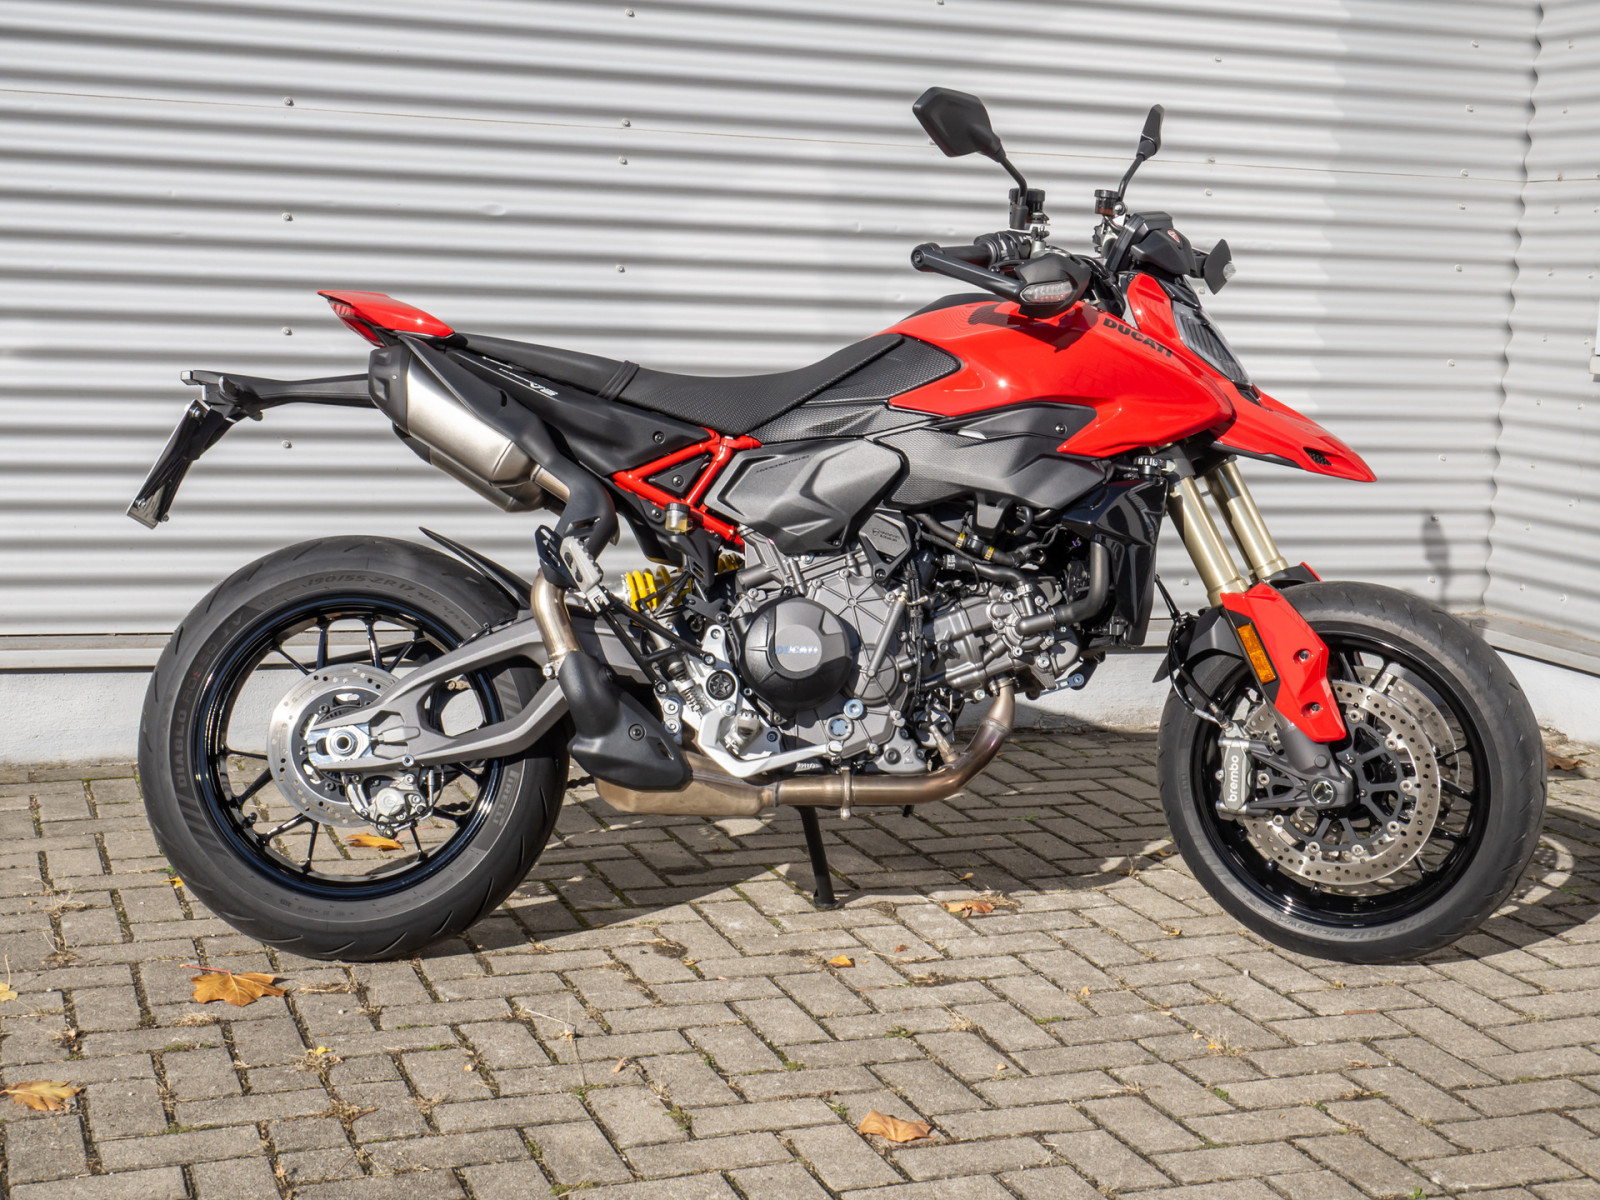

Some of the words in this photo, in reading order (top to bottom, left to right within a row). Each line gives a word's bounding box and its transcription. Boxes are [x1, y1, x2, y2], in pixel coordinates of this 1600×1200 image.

[1103, 317, 1173, 358] DUCATI
[306, 574, 365, 587] 190/55
[174, 709, 188, 788] DIABLO
[181, 640, 219, 704] ROSSO
[493, 769, 520, 826] PIRELLI
[1228, 755, 1239, 802] brembo
